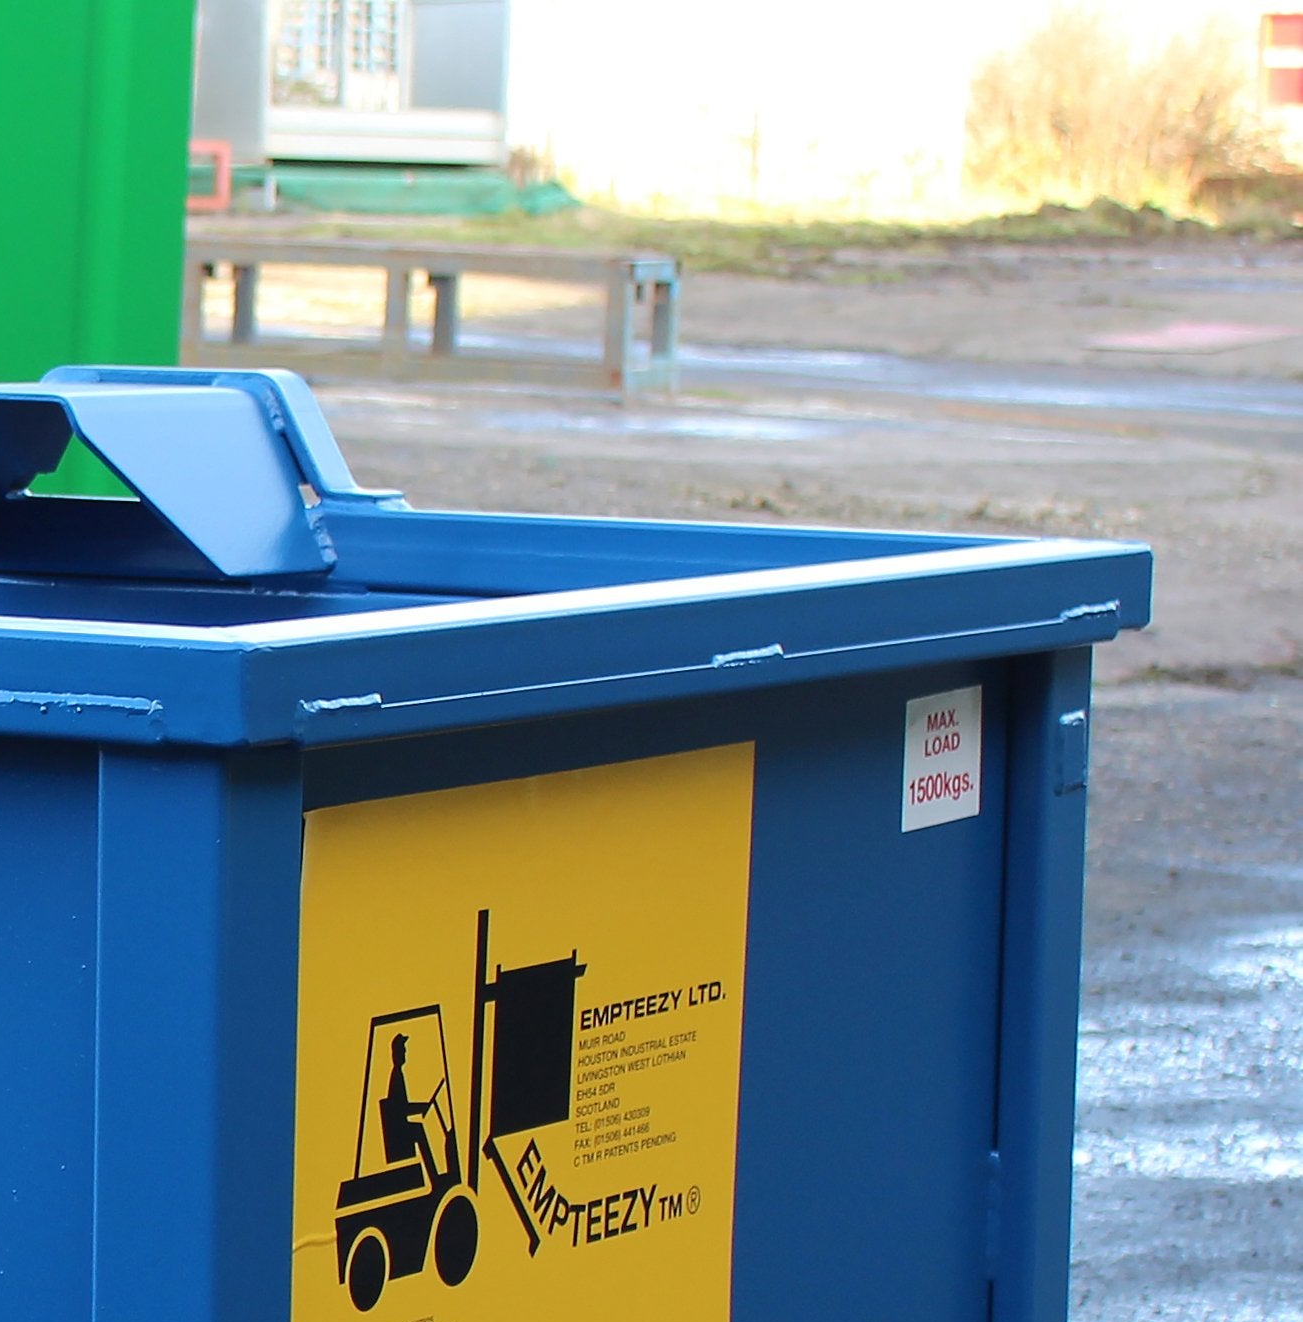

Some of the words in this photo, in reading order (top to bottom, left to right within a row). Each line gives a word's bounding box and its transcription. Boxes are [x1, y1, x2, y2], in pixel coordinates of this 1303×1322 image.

[927, 709, 959, 732] MAX.
[925, 733, 960, 757] LOAD
[910, 772, 973, 805] 1500kgs.
[580, 989, 683, 1031] EMPTEEZY
[689, 981, 726, 1006] LTD.
[578, 1050, 618, 1067] HOUSTON
[620, 1039, 667, 1057] INDUSTRIAL
[669, 1031, 697, 1047] ESTATE
[579, 1038, 600, 1051] MUIR
[602, 1031, 625, 1045] ROAD
[577, 1065, 625, 1084] LIVINGSTON
[628, 1058, 650, 1072] WEST
[652, 1050, 686, 1067] LOTHIAN
[576, 1098, 620, 1118] SCOTLAND
[604, 1140, 639, 1160] PATENTS
[641, 1132, 676, 1149] PENDING
[517, 1138, 657, 1247] EMPTEEZY
